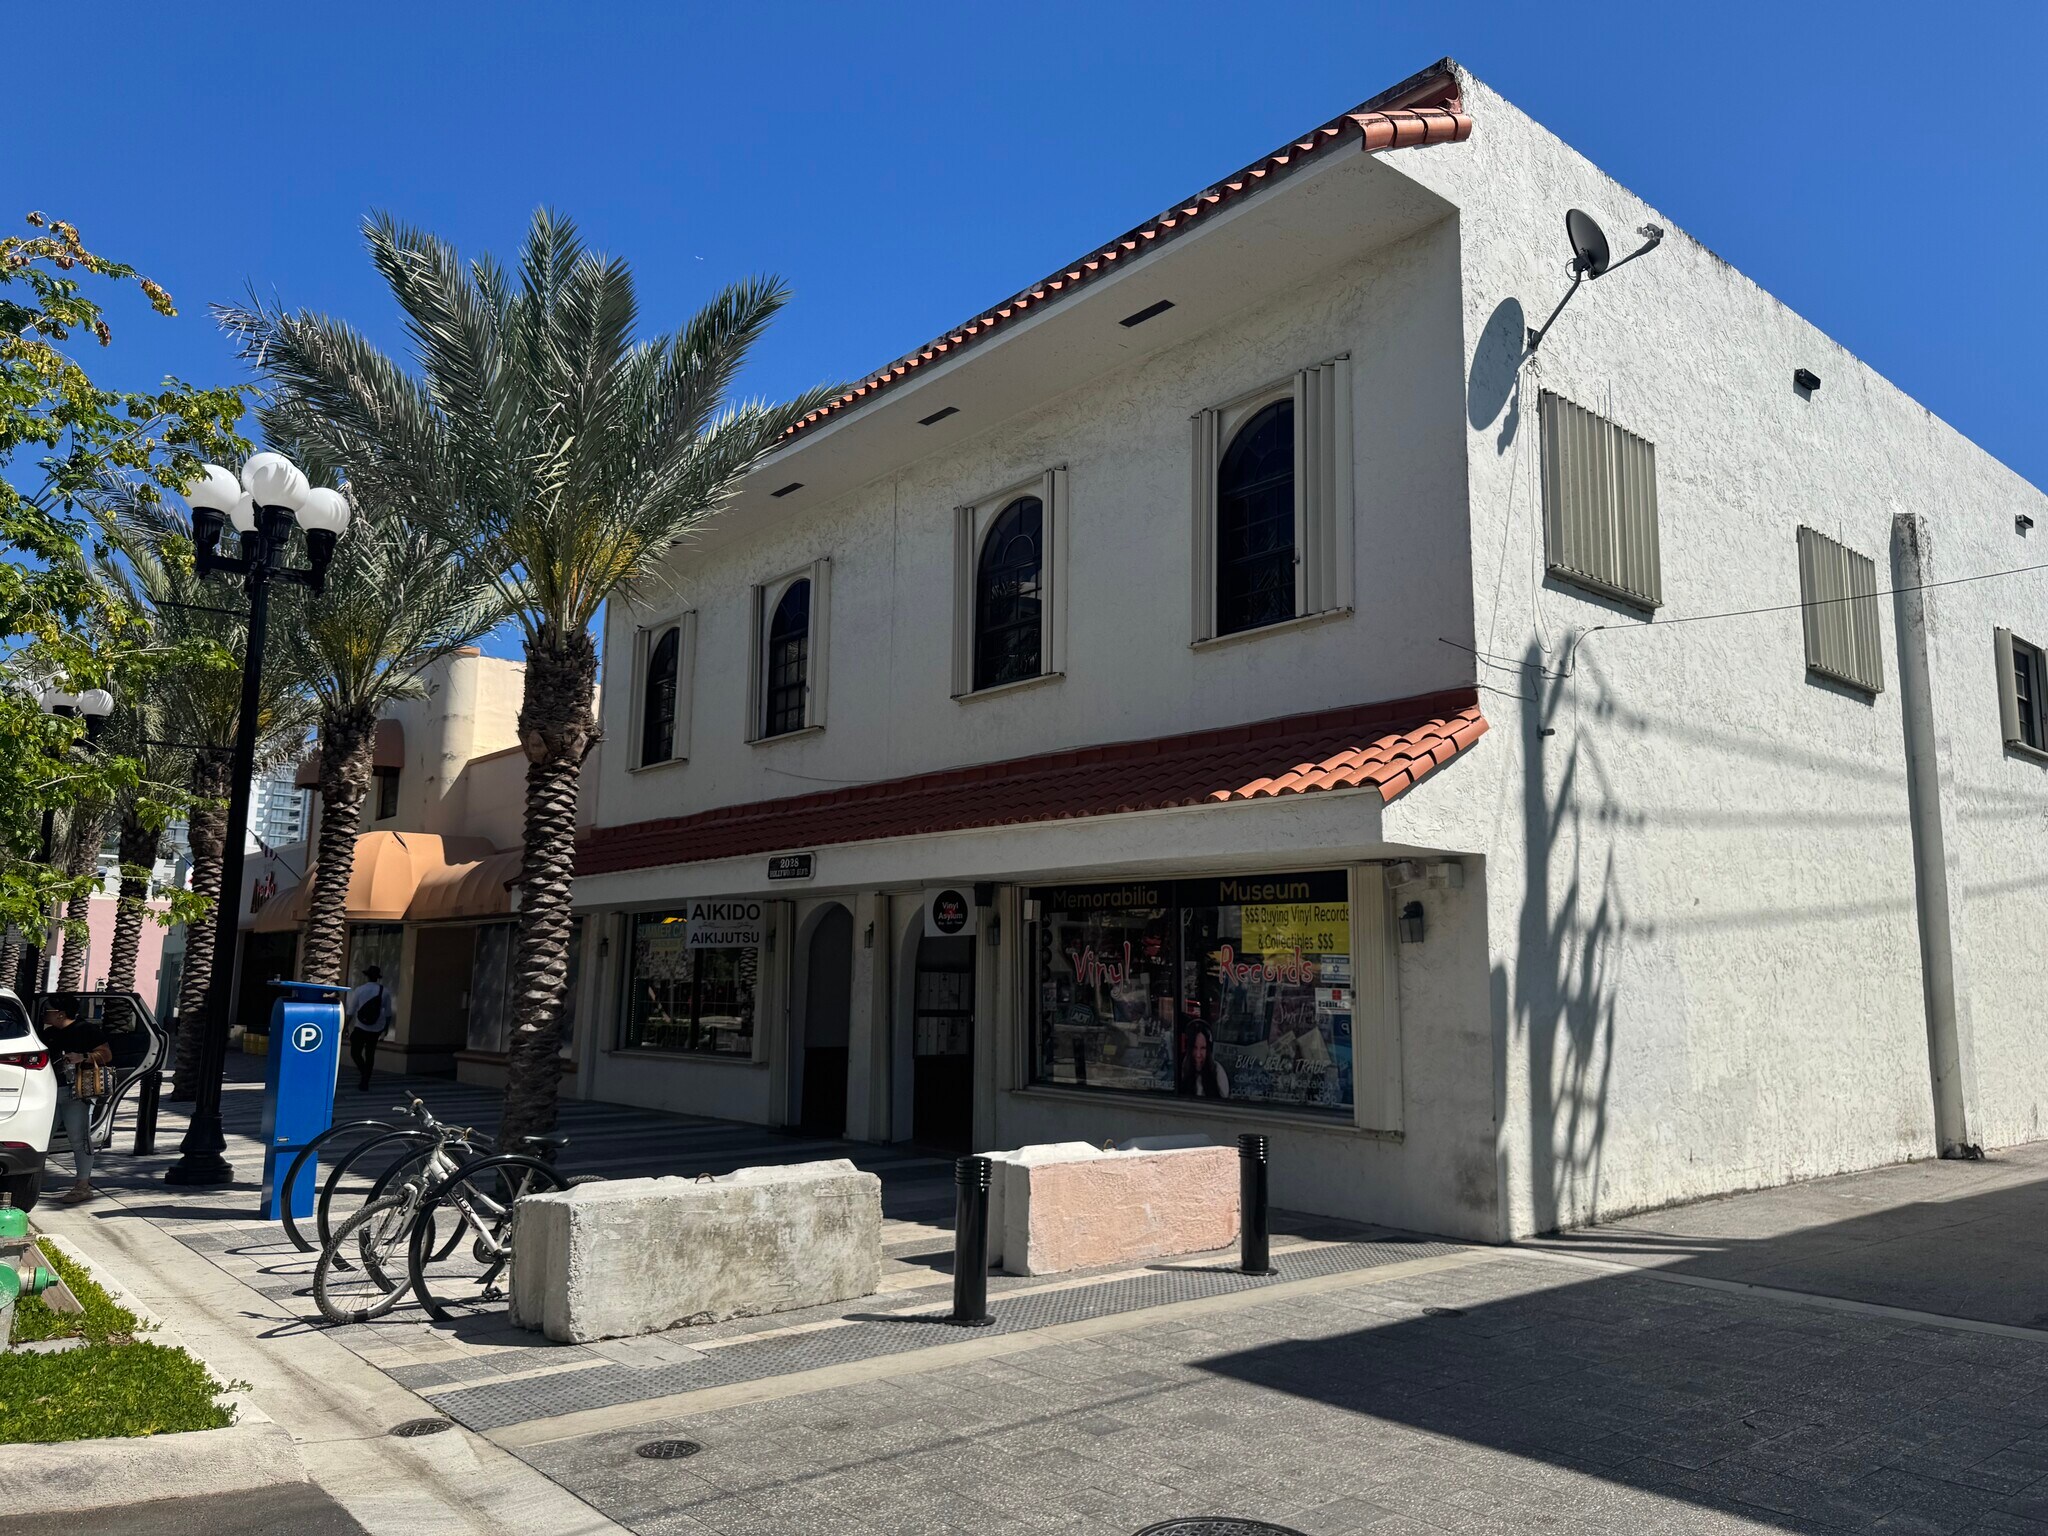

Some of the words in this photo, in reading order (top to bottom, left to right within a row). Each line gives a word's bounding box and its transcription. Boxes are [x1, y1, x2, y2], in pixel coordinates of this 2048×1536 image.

[779, 857, 799, 869] 2028
[1053, 885, 1158, 908] Memorabilia
[1219, 879, 1310, 903] Museum
[691, 903, 761, 921] AIKIDO
[942, 901, 959, 912] Vinyl
[1261, 906, 1289, 927] Buying
[1291, 905, 1311, 926] Vinyl
[1314, 904, 1349, 922] Records
[938, 912, 963, 921] Asylum
[690, 931, 760, 944] AIKIJUTSU
[1258, 933, 1264, 950] &
[1265, 933, 1313, 949] Collectibles
[1318, 932, 1334, 950] $$$
[1072, 940, 1131, 998] Vinyl
[1219, 944, 1314, 988] Records
[1071, 1011, 1090, 1024] ADT
[300, 1027, 317, 1047] P
[1235, 1054, 1257, 1070] BUY
[1264, 1056, 1287, 1071] SELL
[1295, 1058, 1330, 1074] TRADE
